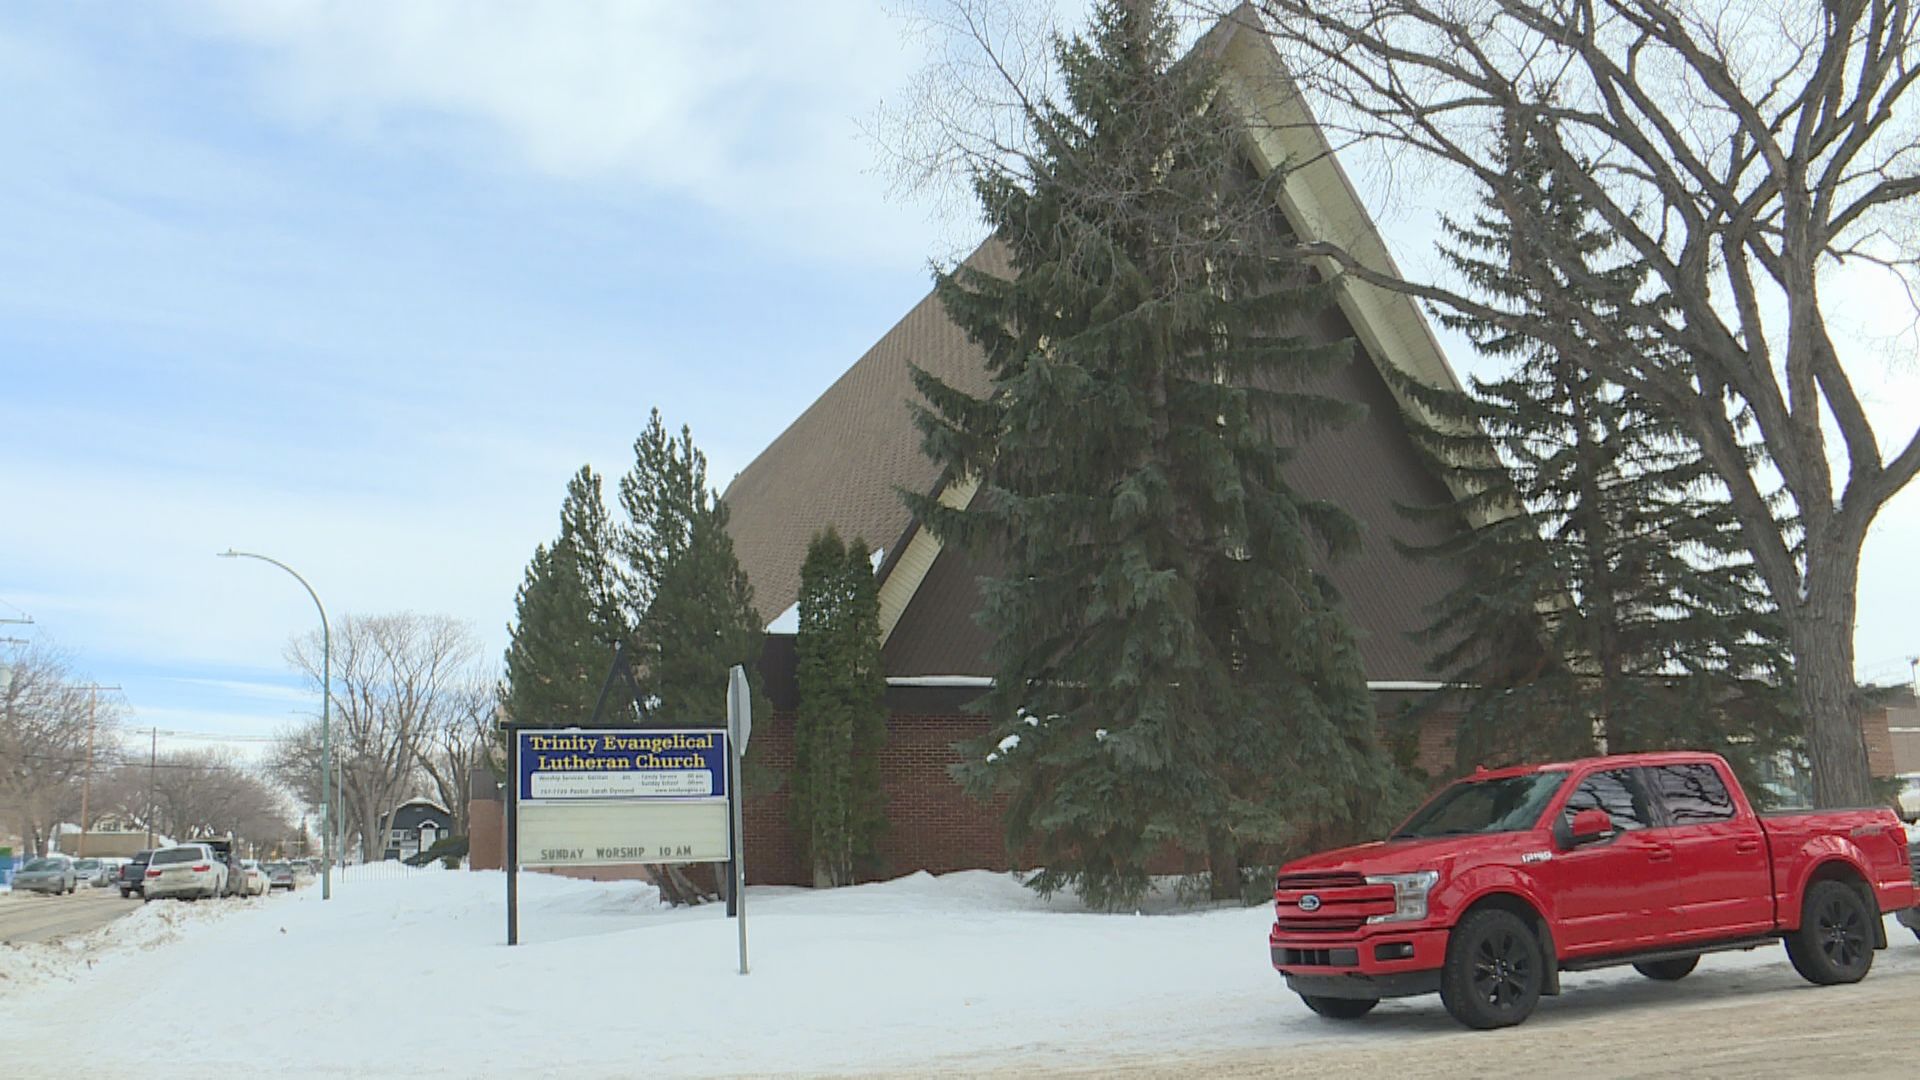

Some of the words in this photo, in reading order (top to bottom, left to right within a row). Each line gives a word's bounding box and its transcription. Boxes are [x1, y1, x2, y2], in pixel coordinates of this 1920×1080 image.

[529, 735, 598, 754] Trinity
[603, 733, 714, 753] Evangelical
[538, 754, 630, 771] Lutheran
[635, 753, 706, 769] Church
[540, 848, 585, 861] SUNDAY
[596, 846, 646, 859] WORSHIP
[659, 846, 671, 857] 10
[675, 845, 693, 856] AM
